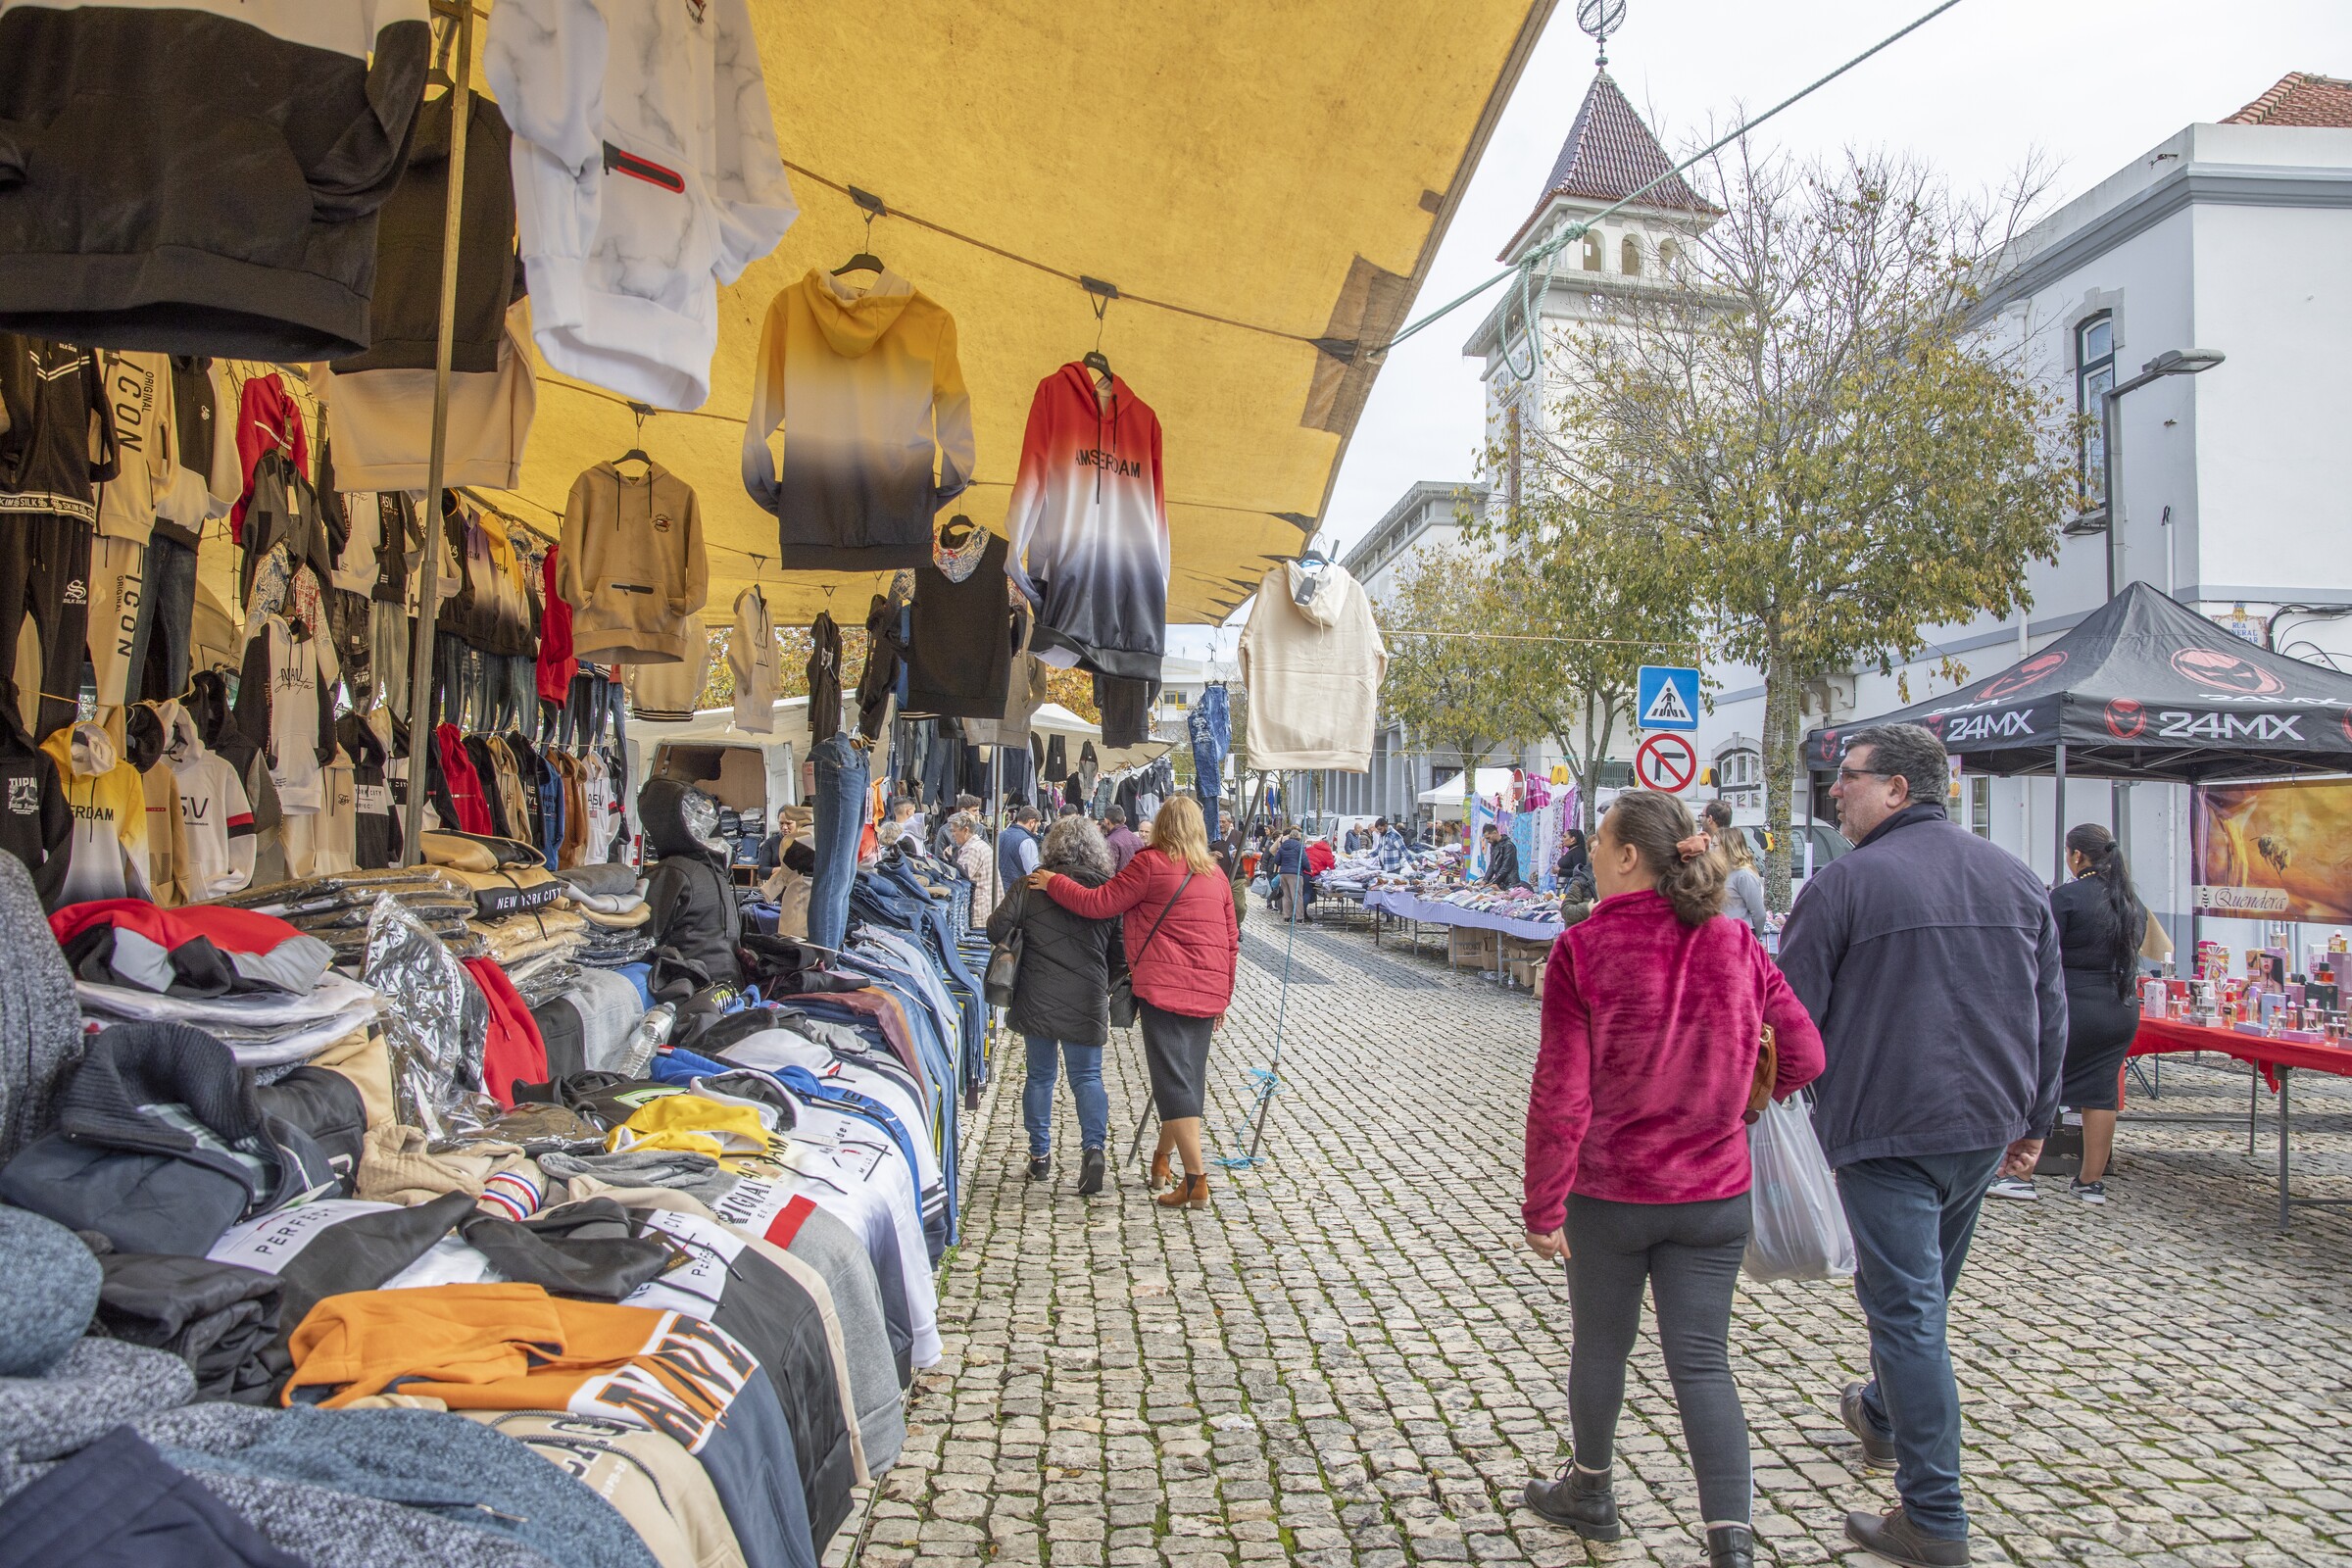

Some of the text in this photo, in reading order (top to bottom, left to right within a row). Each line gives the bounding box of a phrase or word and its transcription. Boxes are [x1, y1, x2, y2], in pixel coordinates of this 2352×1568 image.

[116, 357, 144, 453] ICON
[141, 370, 155, 414] ORIGINAL
[20, 498, 37, 507] SILK
[115, 574, 125, 613] ORIGINAL
[118, 574, 143, 658] ICON
[1946, 709, 2034, 742] 24MX
[2159, 711, 2305, 741] 24MX
[496, 886, 562, 909] NEW YORK CITY
[2214, 887, 2287, 910] Quendera
